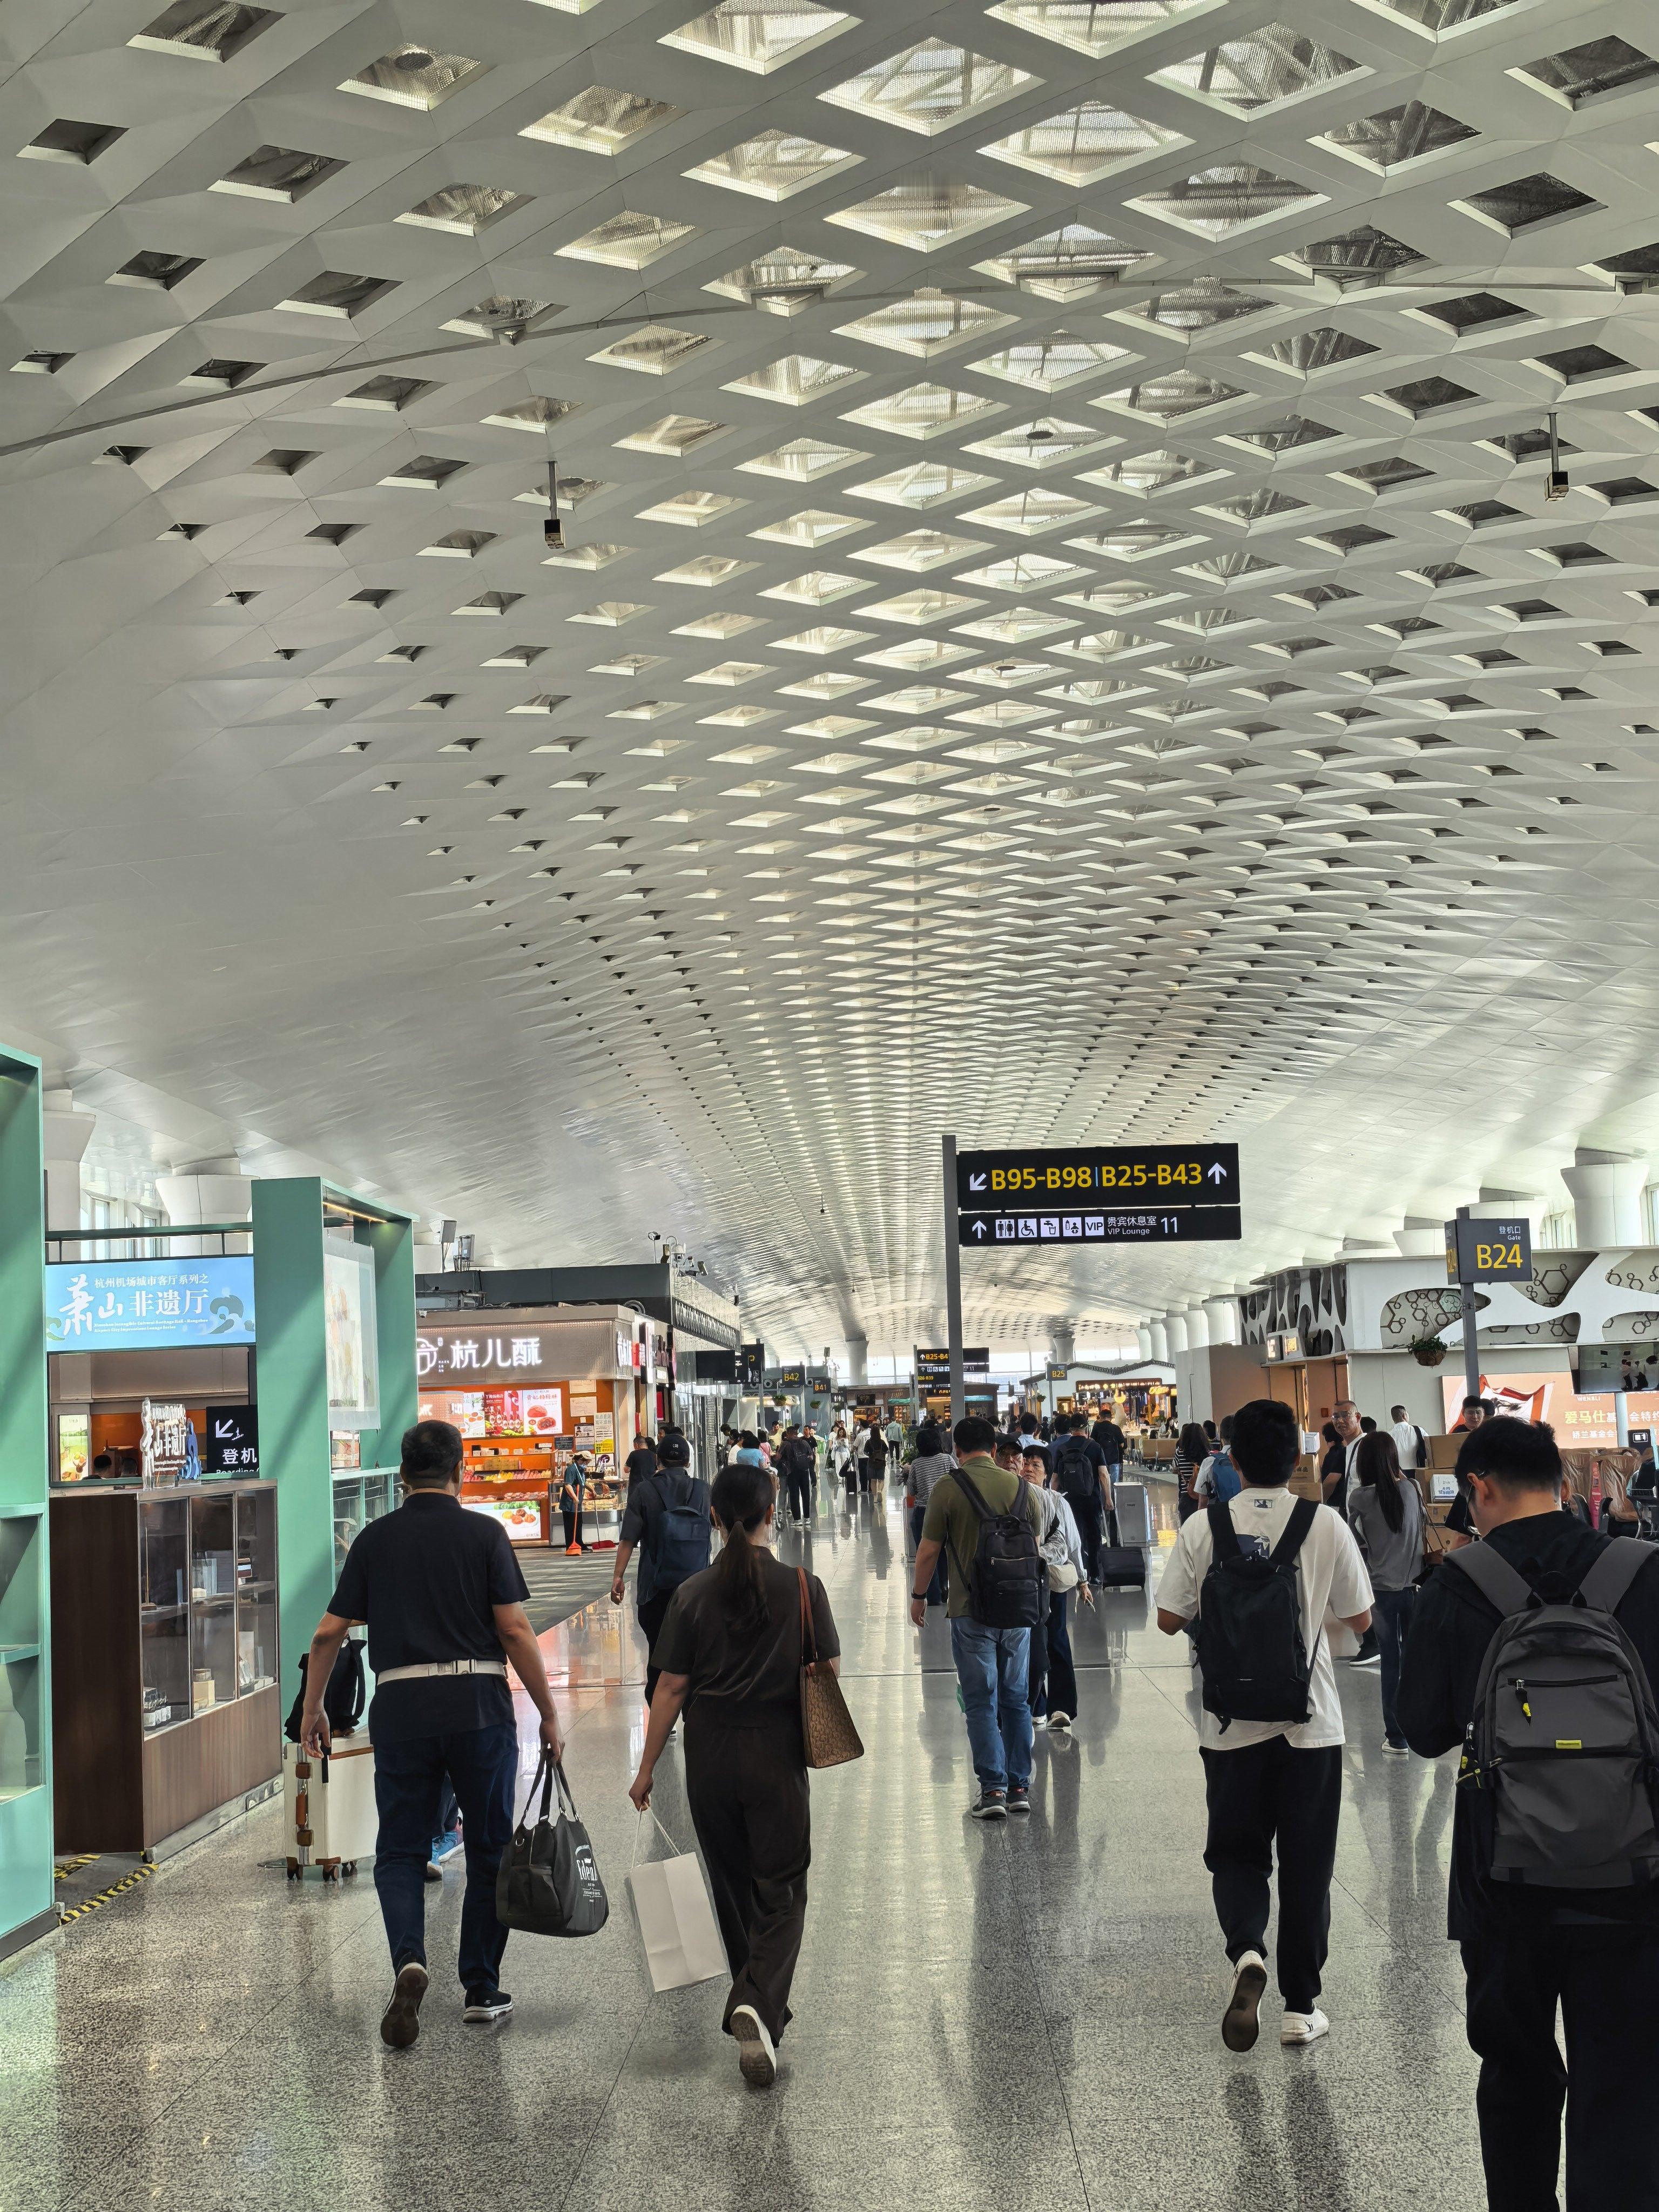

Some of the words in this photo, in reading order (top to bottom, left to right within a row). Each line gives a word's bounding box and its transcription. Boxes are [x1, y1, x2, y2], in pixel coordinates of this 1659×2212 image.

[992, 1166, 1092, 1190] B95-B98
[1102, 1163, 1202, 1187] B25-B43
[1086, 1222, 1103, 1231] VIP
[1107, 1216, 1157, 1226] 贵宾休息室
[1161, 1217, 1178, 1233] 11
[1122, 1228, 1150, 1236] Lounge
[1499, 1226, 1521, 1234] 登机口
[1476, 1244, 1523, 1269] B24
[94, 1273, 210, 1289] 杭州机场城市客厅系列之
[450, 1337, 542, 1368] 杭儿酥
[784, 1373, 799, 1381] B42
[222, 1447, 257, 1465] 登机
